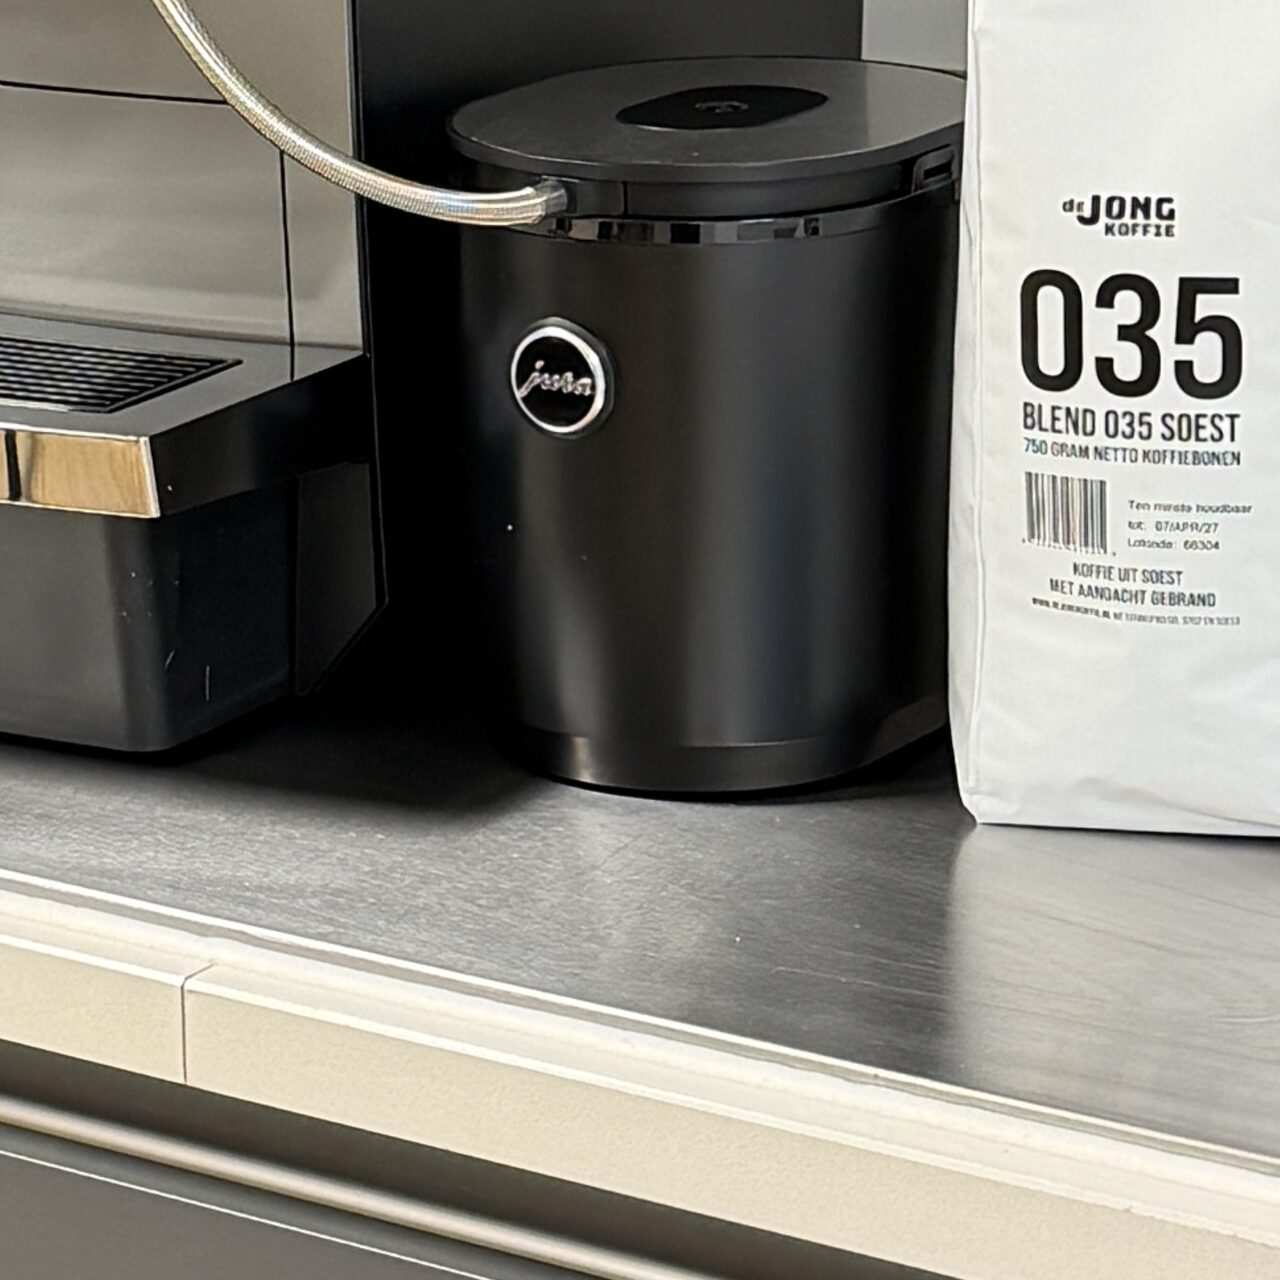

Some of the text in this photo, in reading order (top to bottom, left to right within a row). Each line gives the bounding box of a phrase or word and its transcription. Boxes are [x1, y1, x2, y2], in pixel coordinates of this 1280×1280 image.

[1077, 195, 1176, 225] JONG
[1104, 223, 1175, 237] KOFFIE
[1020, 269, 1243, 400] 035
[519, 360, 592, 398] jura
[1022, 402, 1241, 443] BLEND 035 SOEST
[1023, 437, 1241, 466] 750 GRAM NETTO KOFFIEBONEN
[1073, 562, 1183, 586] KOFFIE UIT SOEST
[1050, 578, 1217, 607] MET AANDACHT GEBRAND
